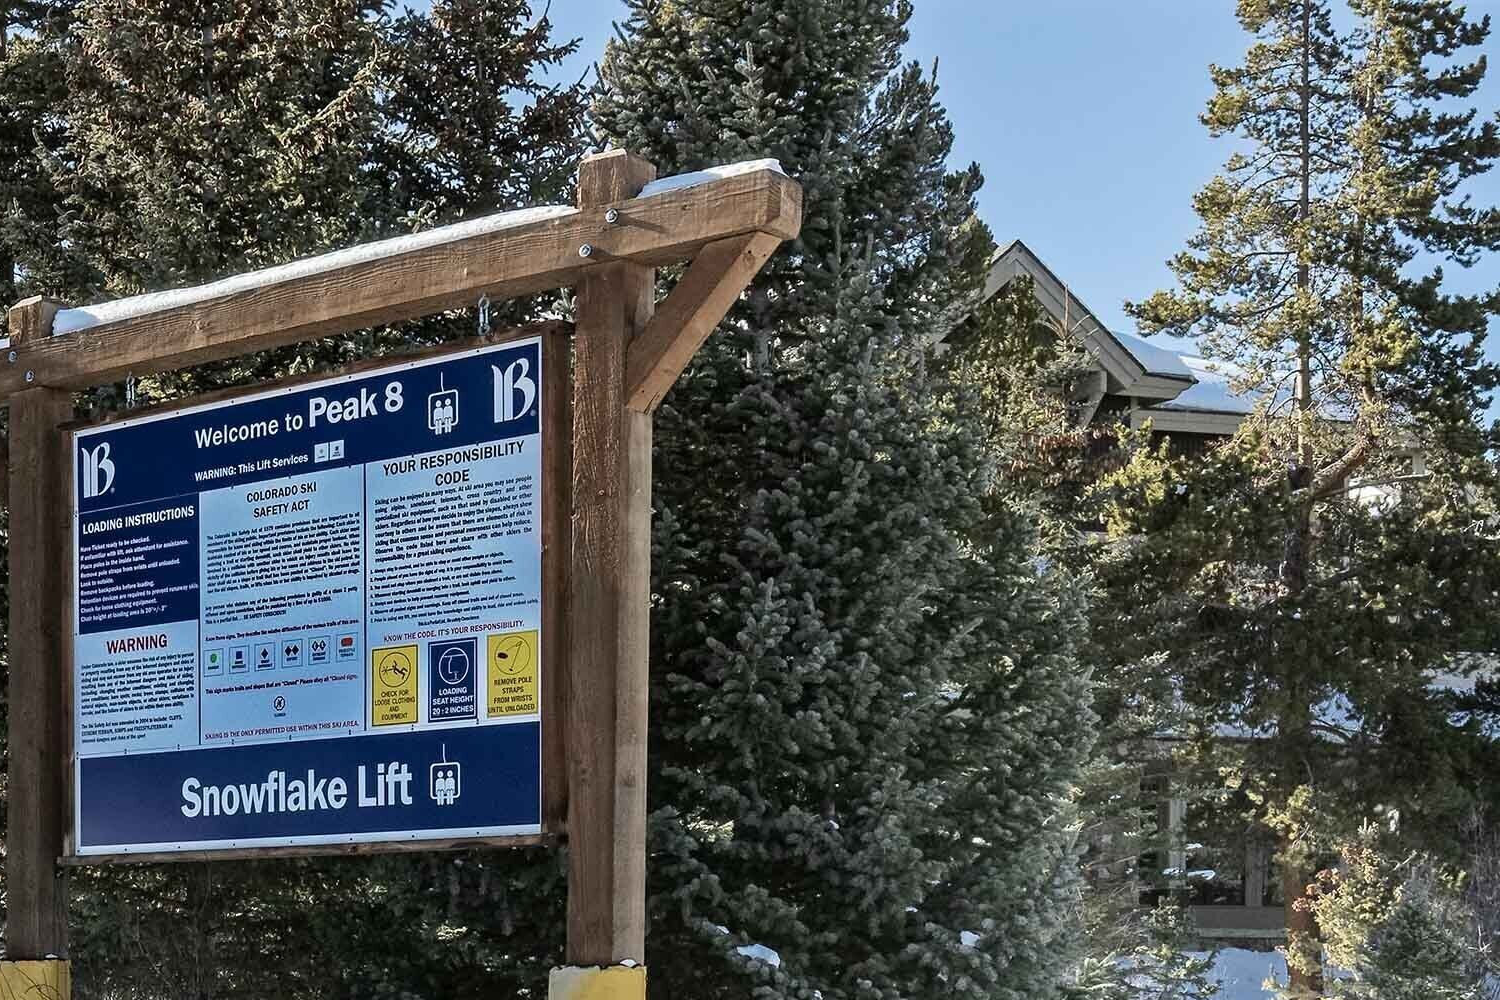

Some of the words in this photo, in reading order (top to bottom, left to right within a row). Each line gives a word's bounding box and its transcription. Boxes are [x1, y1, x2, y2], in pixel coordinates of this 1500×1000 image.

[195, 414, 278, 449] Welcome
[285, 410, 302, 432] to
[309, 385, 377, 427] Peak
[384, 380, 403, 413] 8
[194, 465, 236, 481] WARNING:
[238, 461, 254, 473] This
[257, 458, 270, 470] Lift
[272, 452, 308, 467] Services
[383, 459, 415, 476] YOUR
[420, 440, 524, 470] RESPONSIBILITY
[435, 468, 469, 486] CODE
[246, 484, 297, 503] COLORADO
[300, 481, 316, 494] SKI
[82, 517, 122, 534] LOADING
[125, 505, 194, 527] INSTRUCTIONS
[253, 502, 289, 518] SAFETY
[291, 499, 309, 512] ACT
[106, 633, 167, 654] WARNING
[432, 697, 448, 705] SEAT
[449, 694, 473, 703] HEIGHT
[439, 686, 467, 695] LOADING
[181, 769, 347, 818] Snowflake
[358, 762, 413, 808] Lift
